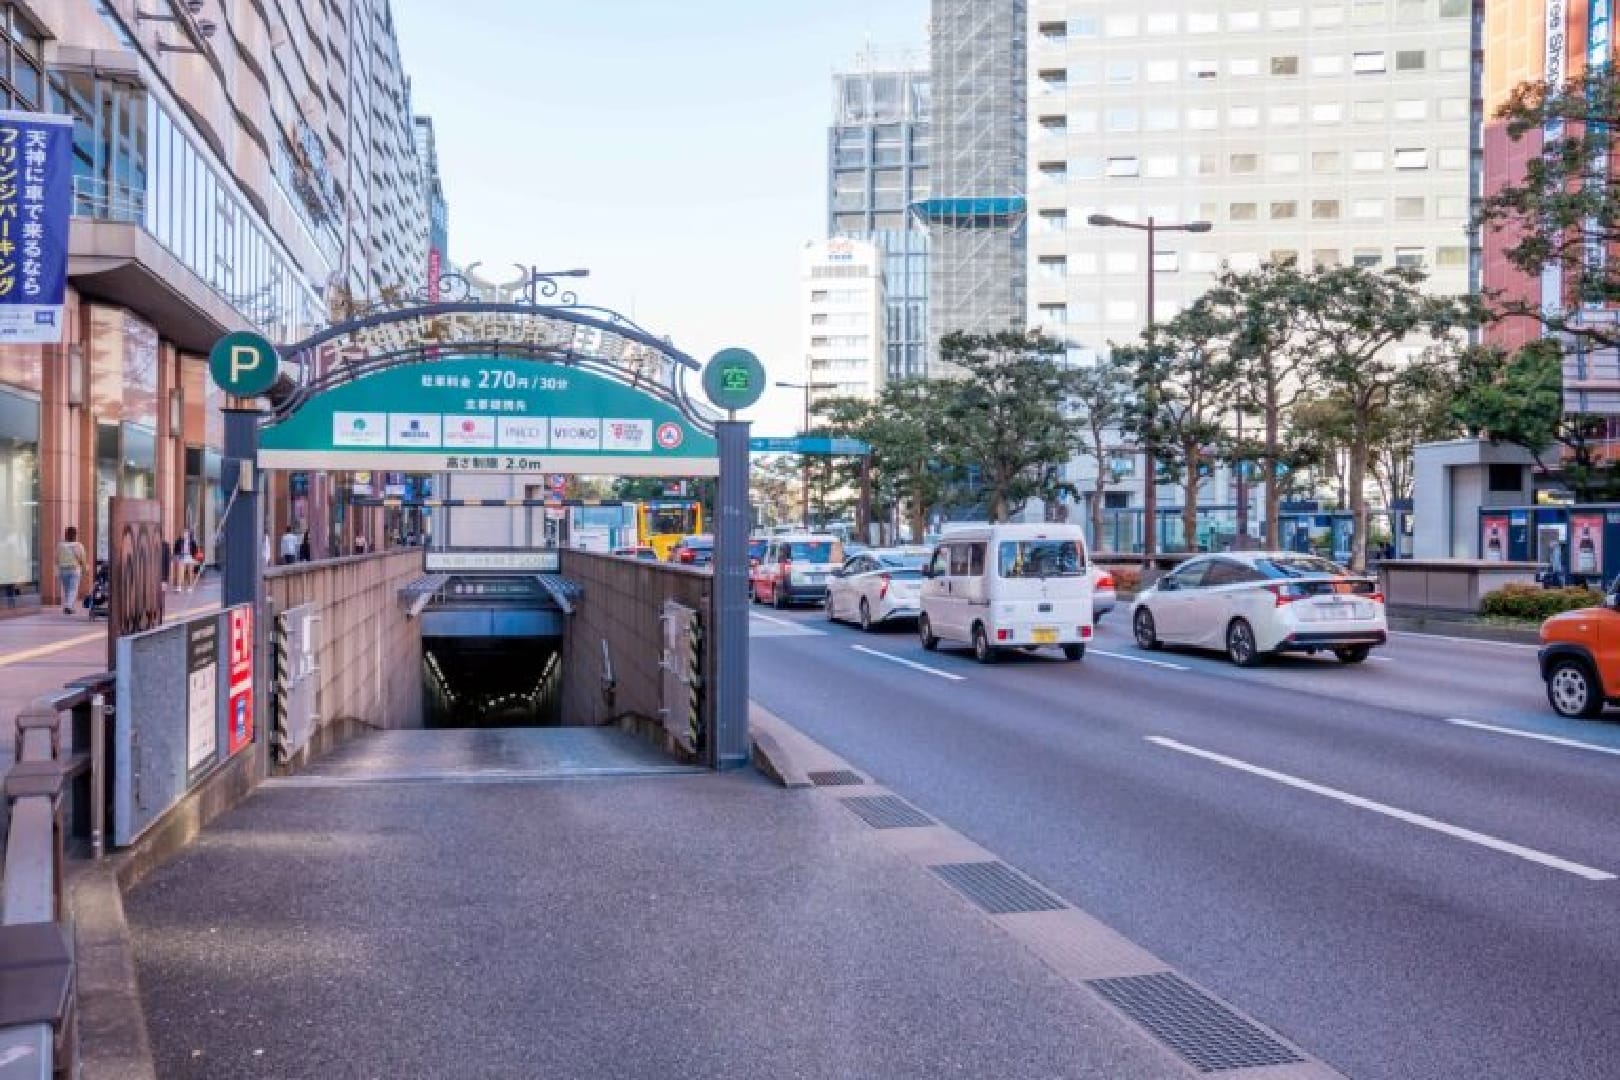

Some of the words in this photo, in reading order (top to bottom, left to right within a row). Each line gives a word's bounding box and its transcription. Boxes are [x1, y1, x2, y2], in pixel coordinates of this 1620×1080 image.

[23, 130, 47, 295] 天神に車で来るなら
[231, 345, 260, 384] P
[723, 366, 748, 391] 空
[505, 457, 541, 470] 2.0m
